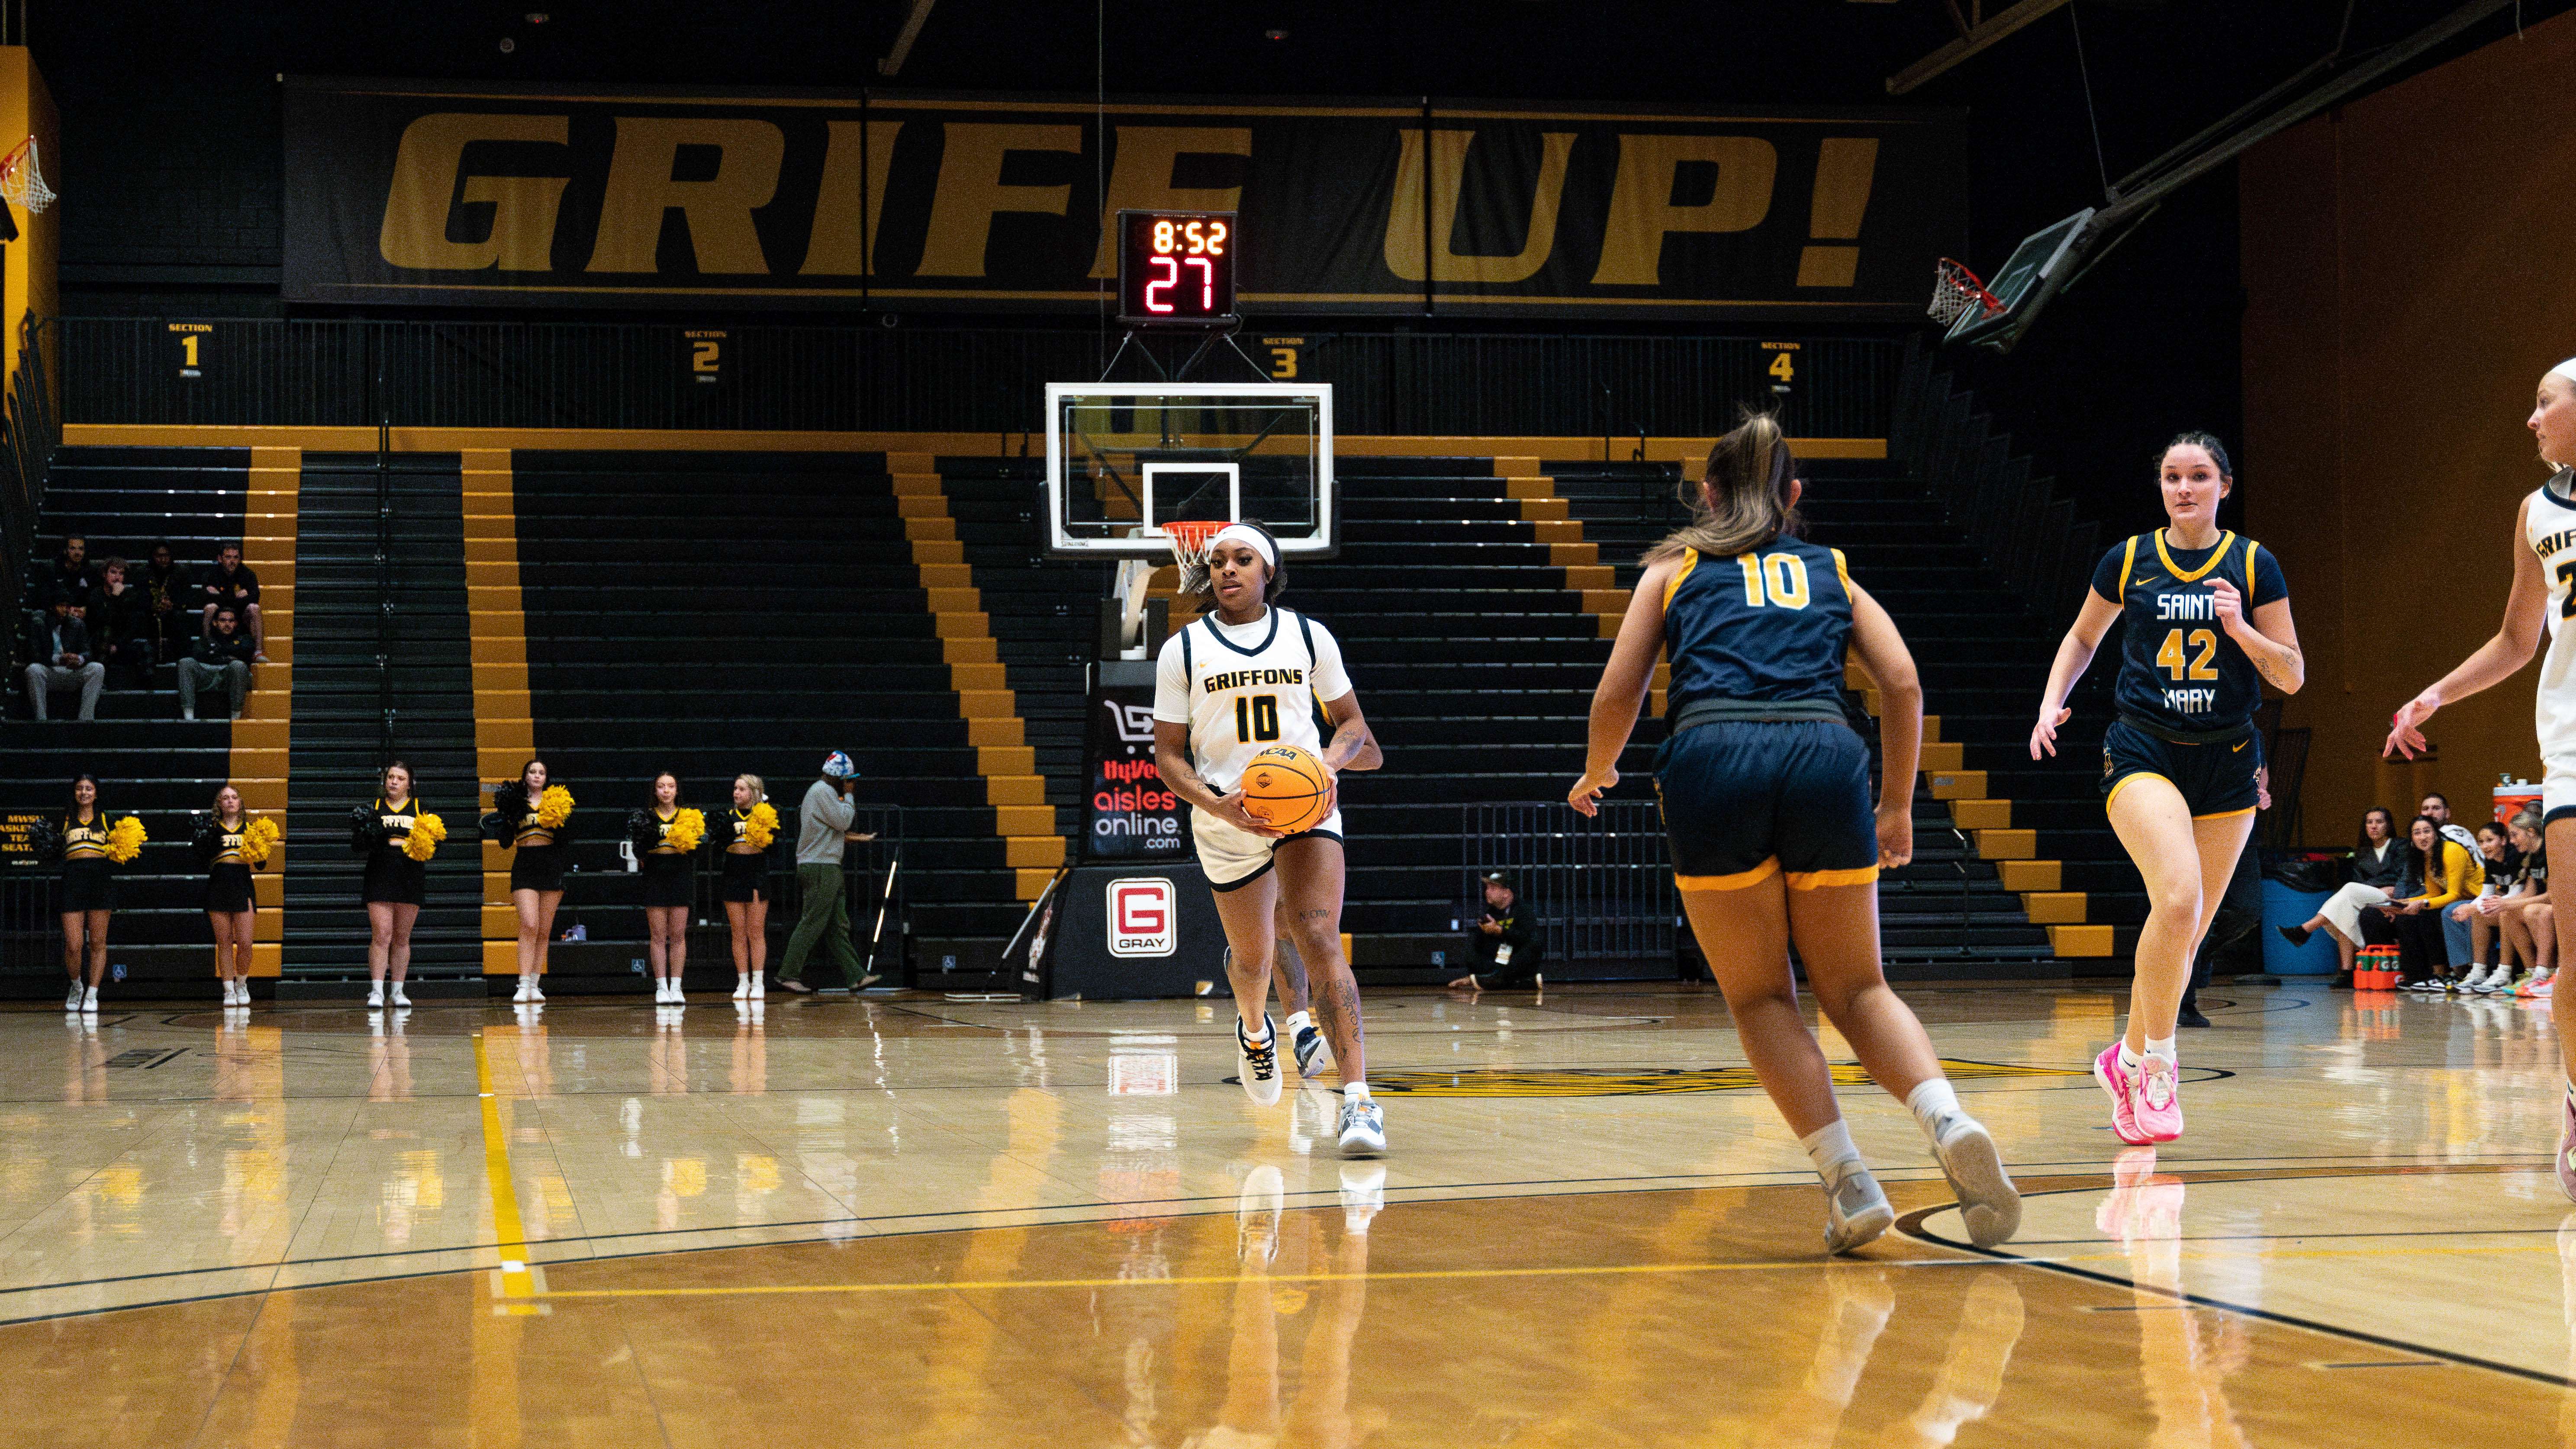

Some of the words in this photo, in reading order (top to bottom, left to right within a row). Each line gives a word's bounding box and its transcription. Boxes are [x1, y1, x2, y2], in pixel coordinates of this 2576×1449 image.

[380, 113, 1253, 279] GRIFF
[1384, 130, 1879, 286] UP!
[1153, 221, 1226, 256] 8:52
[1145, 257, 1212, 312] 27
[168, 323, 213, 332] SECTION
[684, 331, 728, 339] SECTION
[1262, 337, 1304, 345] SECTION
[182, 334, 198, 366] 1
[692, 341, 720, 372] 2
[1761, 342, 1801, 350] SECTION
[1271, 347, 1298, 378] 3
[1768, 352, 1795, 382] 4
[1736, 552, 1810, 610] 10
[2157, 594, 2215, 620] SAINT
[2157, 629, 2218, 680] 42
[1204, 668, 1303, 694] GRIFFONS
[2161, 688, 2216, 713] MARY
[1235, 694, 1281, 744] 10
[1093, 784, 1177, 812] aisles
[1095, 812, 1179, 835] online
[1144, 838, 1181, 849] .com
[1118, 888, 1164, 934] G
[1119, 938, 1165, 948] GRAY
